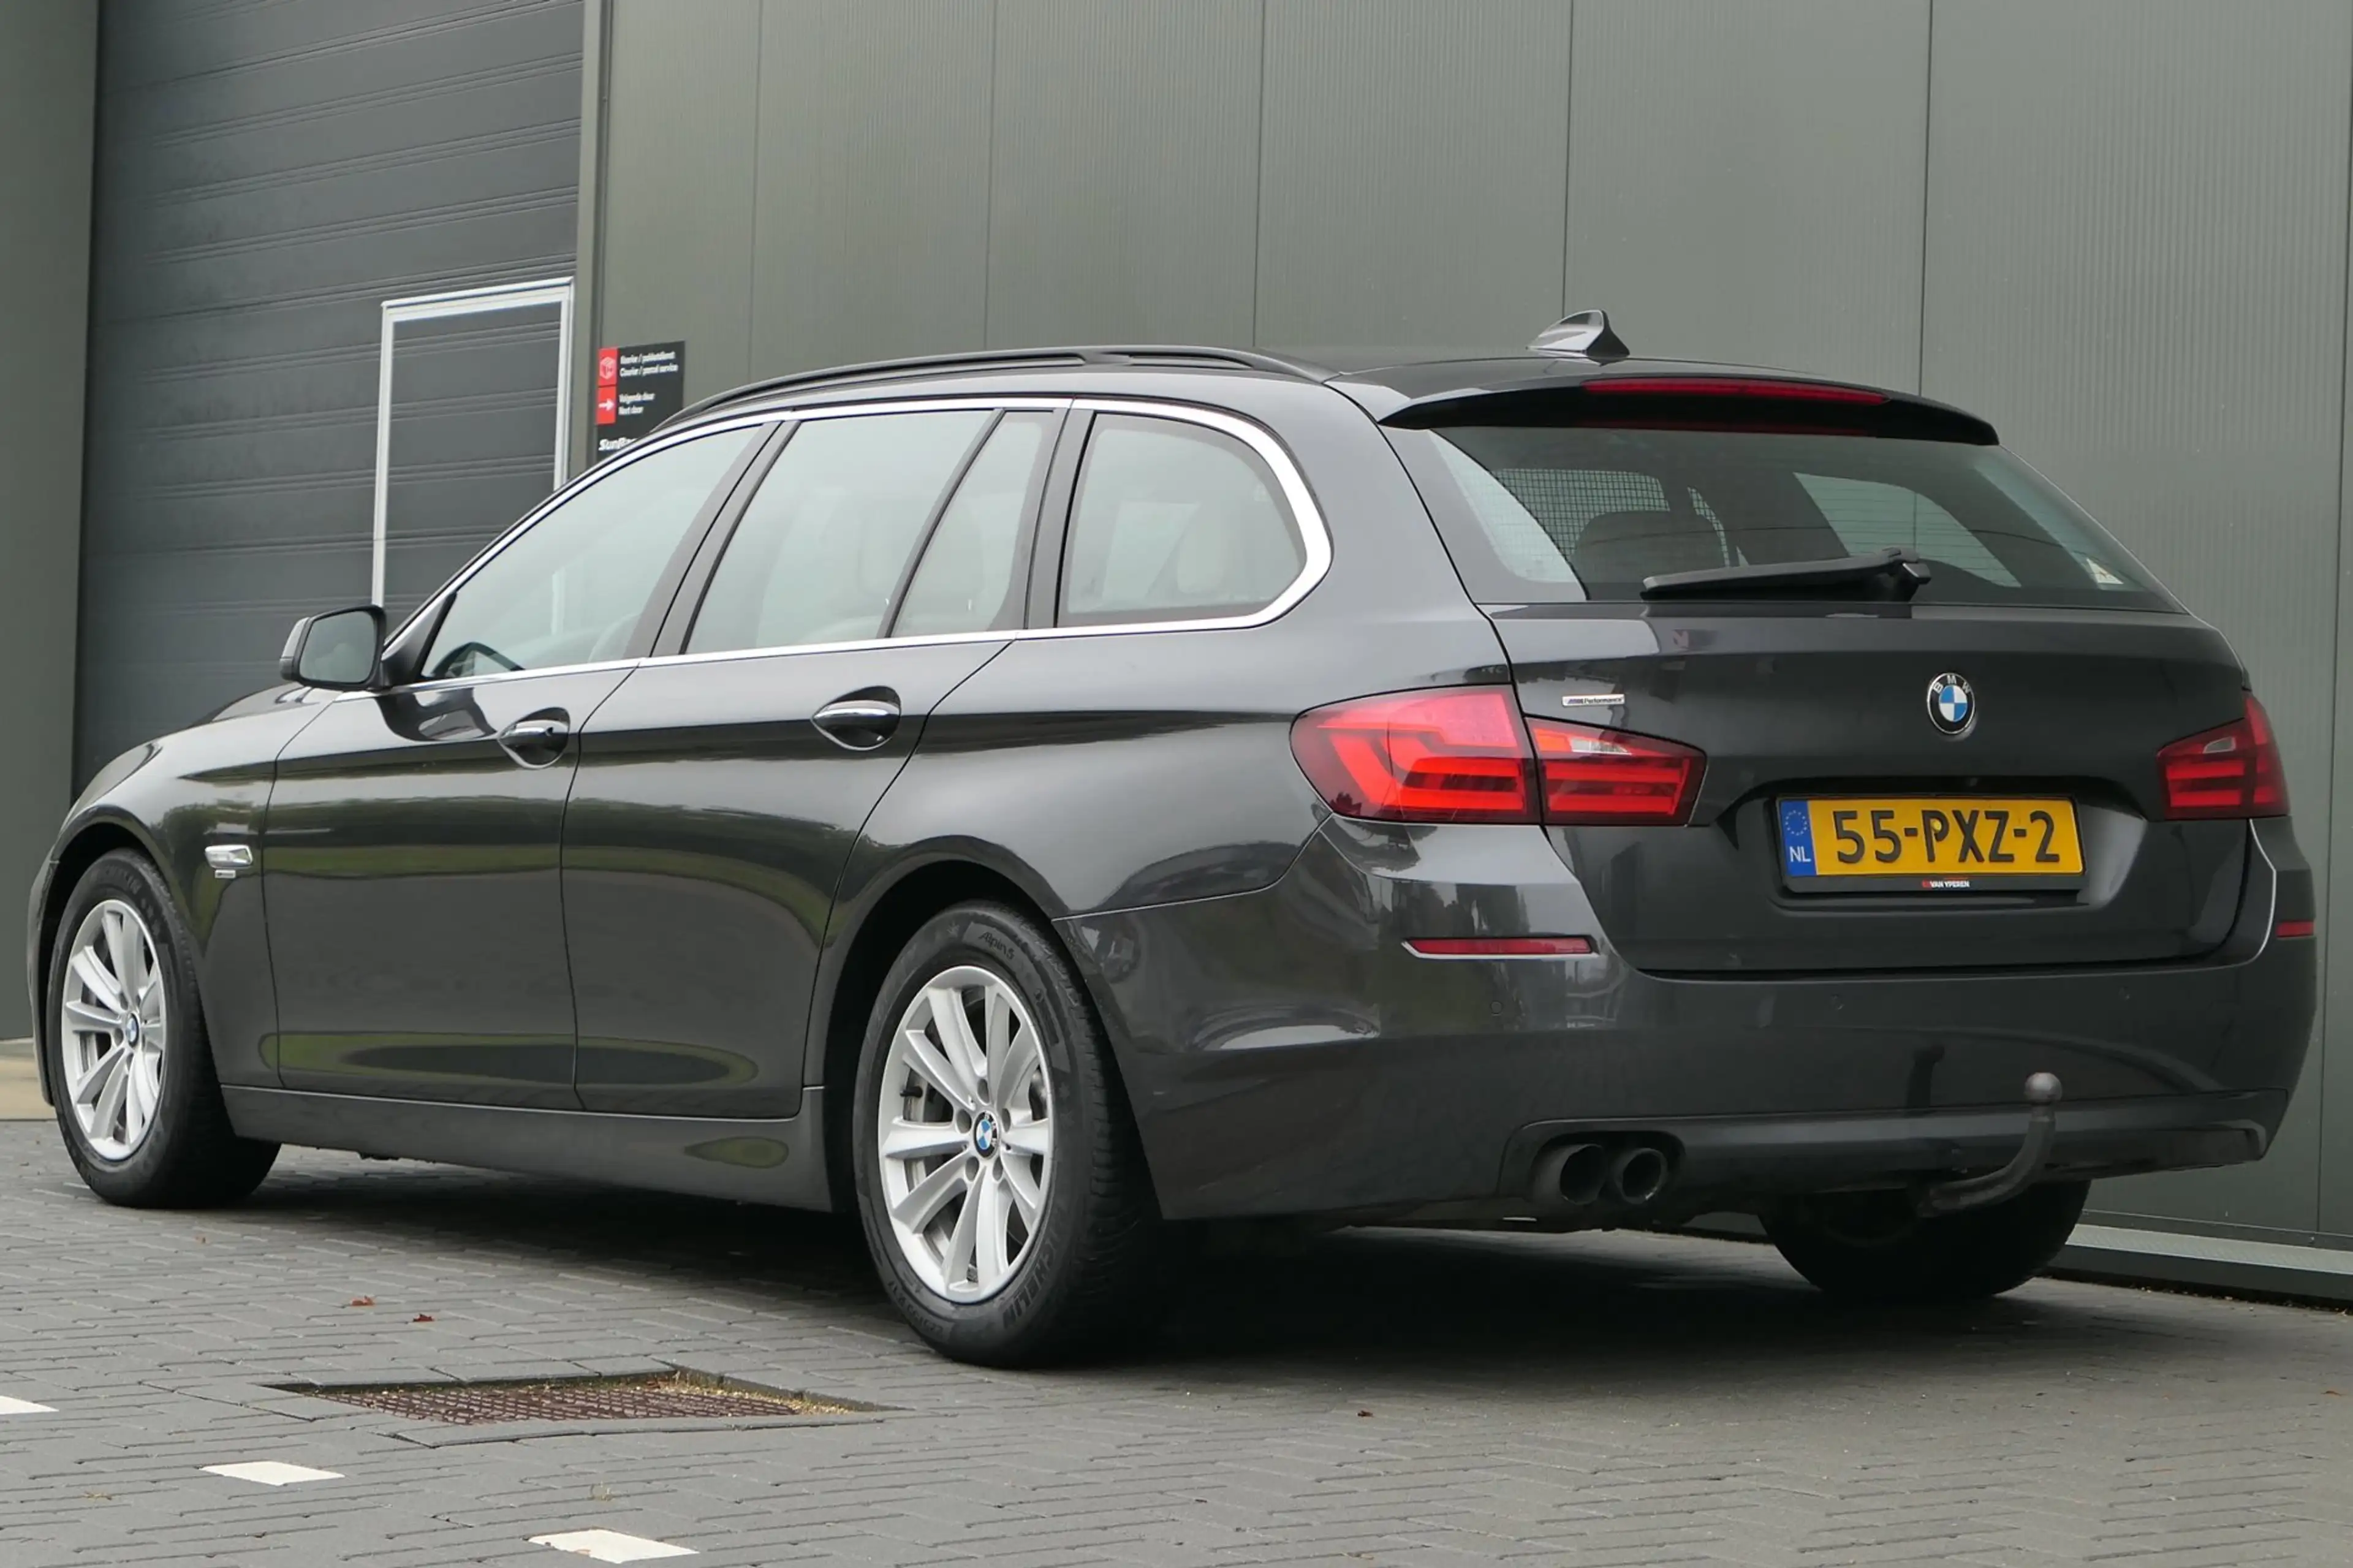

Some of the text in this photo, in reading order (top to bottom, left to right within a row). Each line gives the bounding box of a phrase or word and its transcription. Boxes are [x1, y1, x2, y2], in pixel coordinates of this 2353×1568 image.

[620, 367, 638, 377] Courier
[660, 363, 678, 373] service
[618, 406, 631, 415] Next
[1833, 809, 2061, 864] 55-PXZ-2
[1790, 846, 1812, 863] NL
